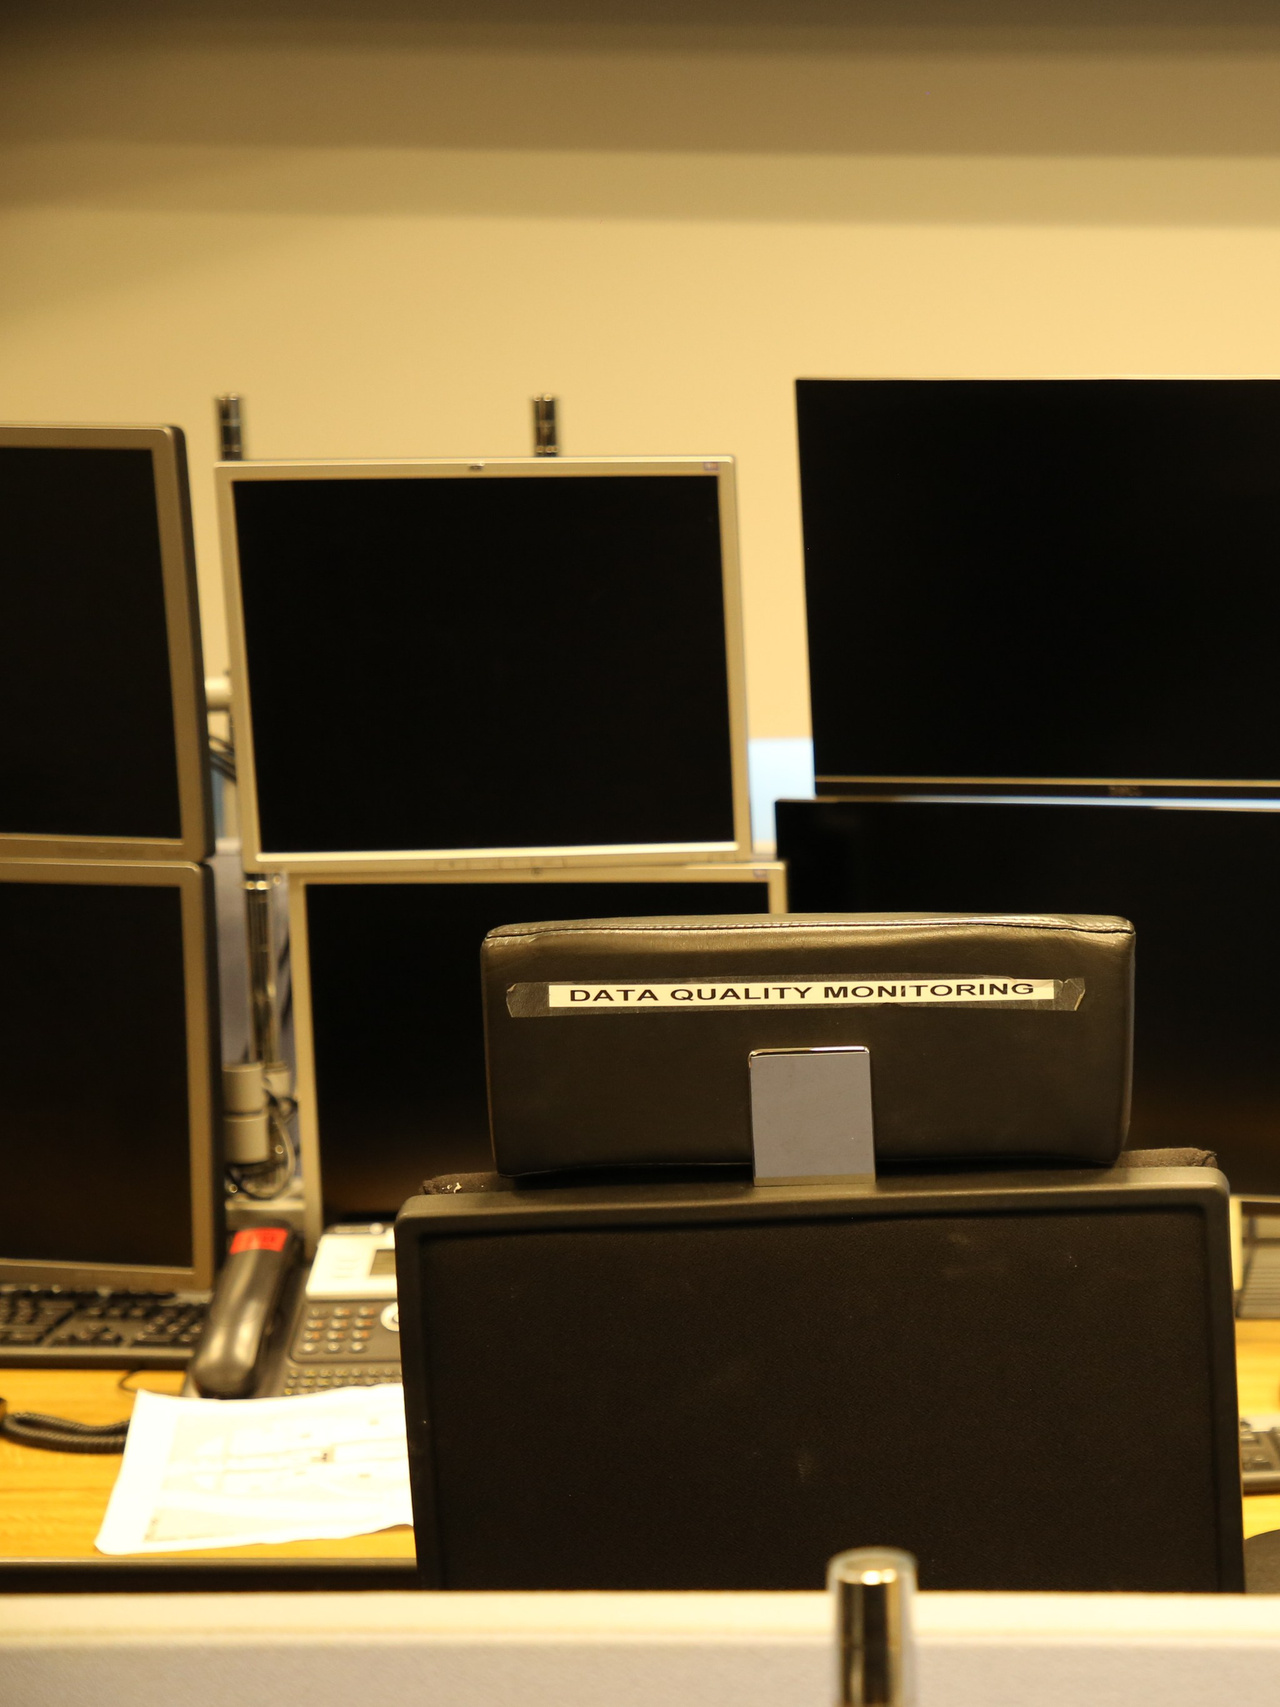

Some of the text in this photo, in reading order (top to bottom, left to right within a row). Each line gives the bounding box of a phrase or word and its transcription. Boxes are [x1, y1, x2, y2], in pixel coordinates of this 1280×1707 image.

[569, 981, 1036, 1003] DATA QUALITY MONITORING
